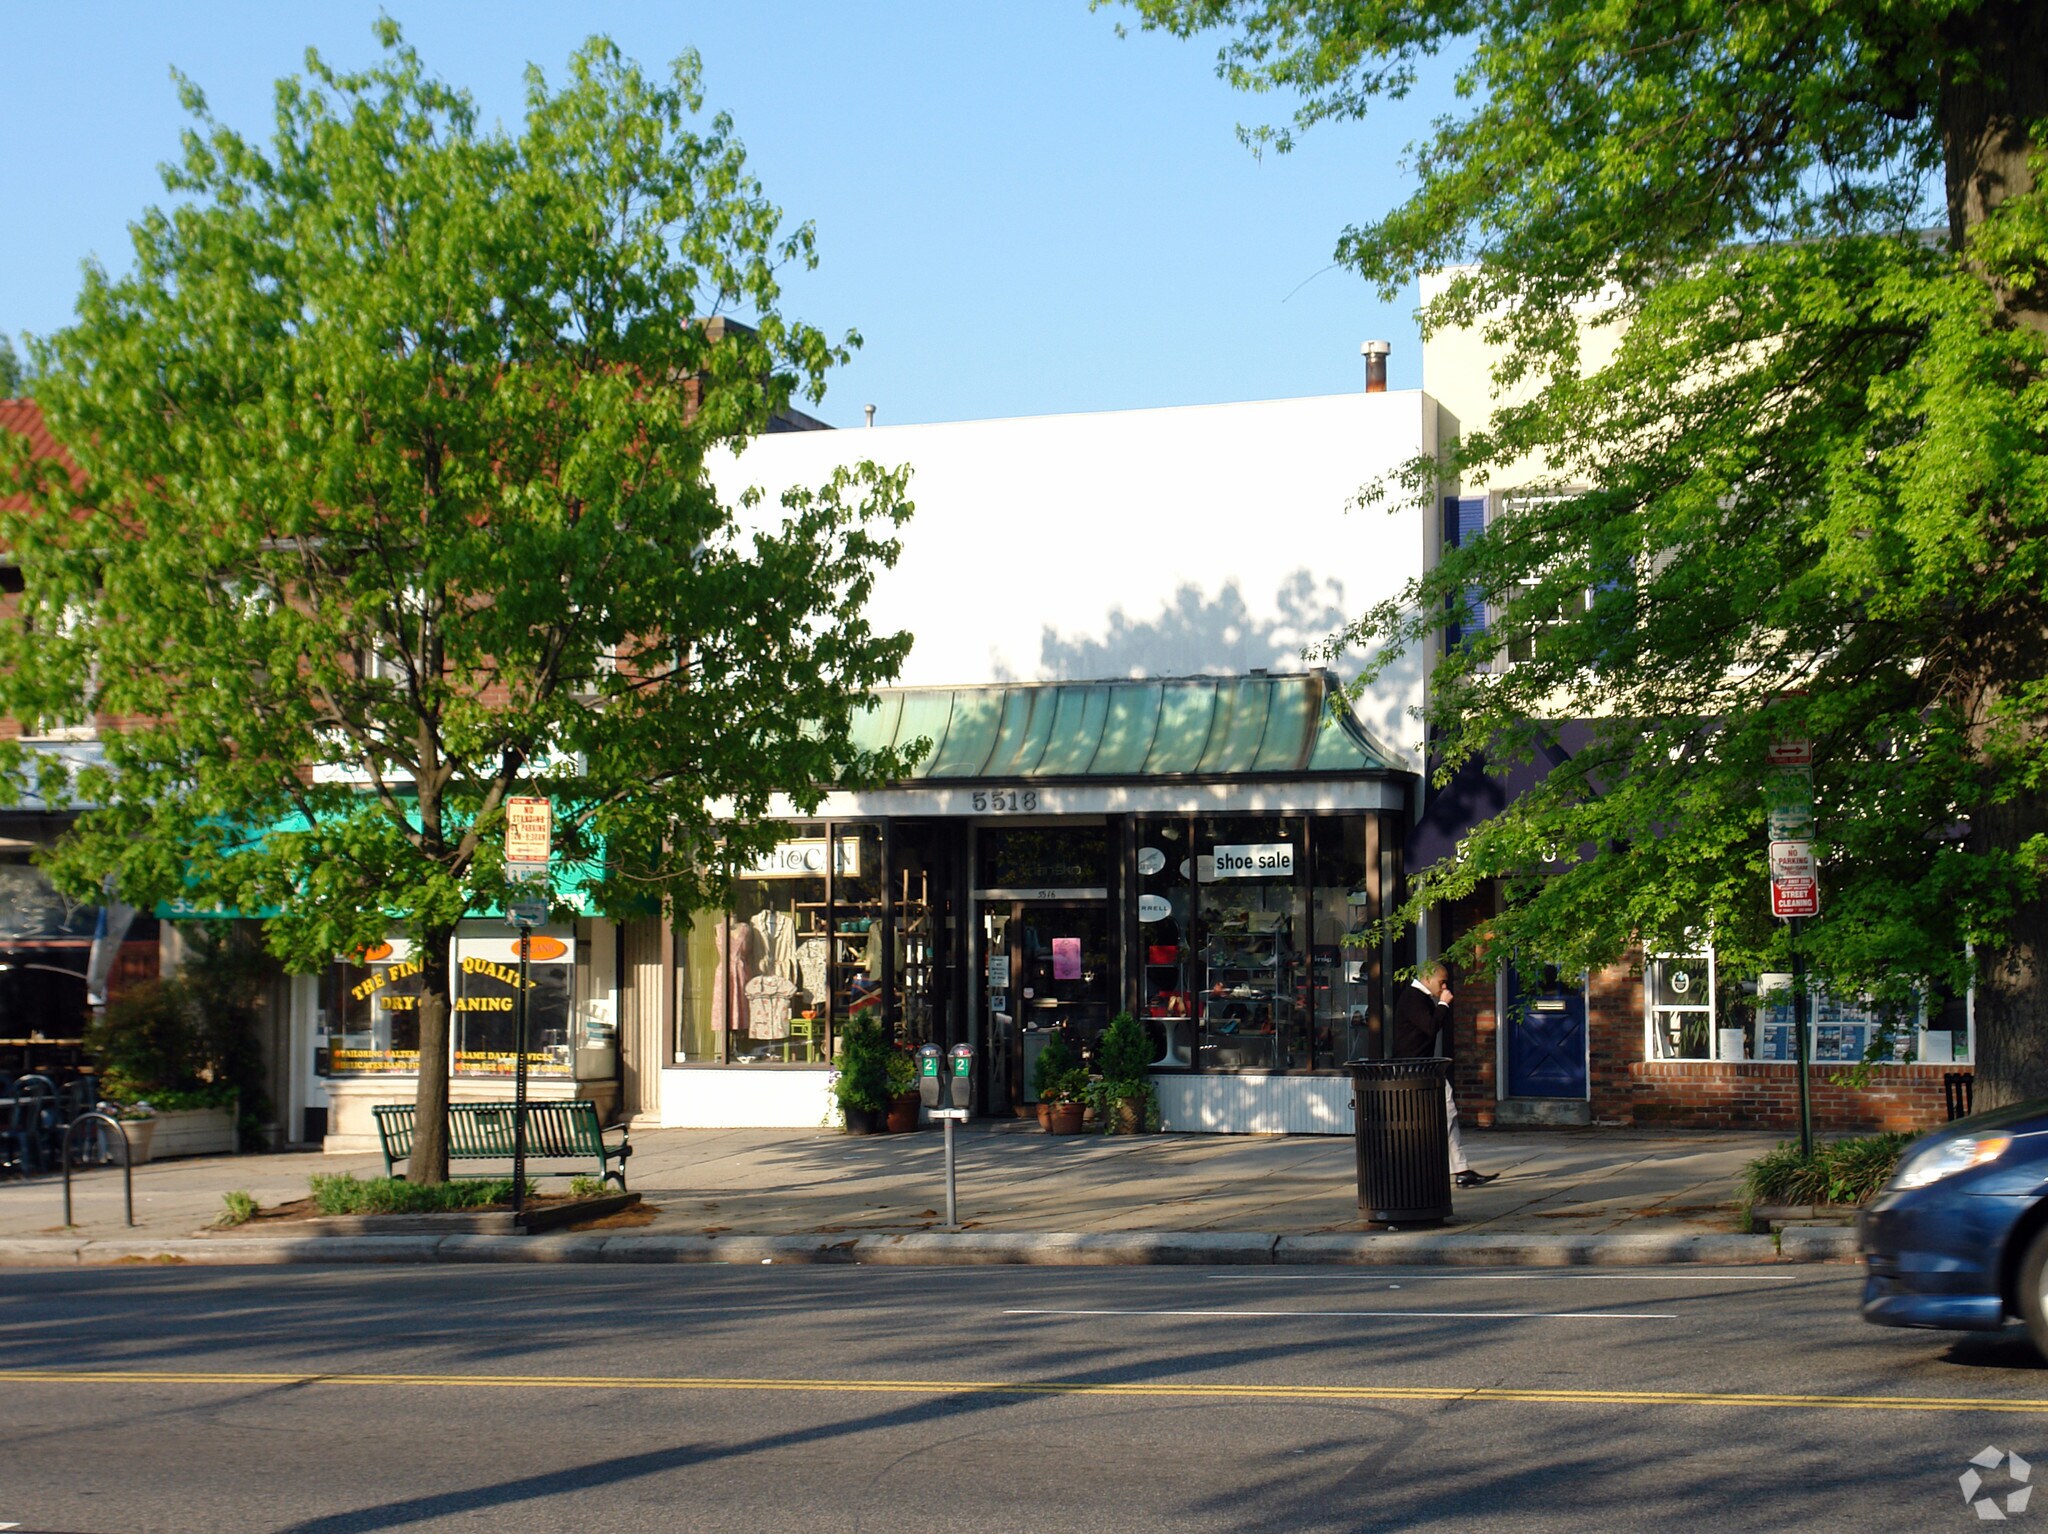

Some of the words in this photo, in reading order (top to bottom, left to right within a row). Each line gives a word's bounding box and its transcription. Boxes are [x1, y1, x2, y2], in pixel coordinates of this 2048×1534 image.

[972, 791, 1037, 811] 5518
[523, 806, 534, 814] NO
[512, 815, 545, 823] STANDING
[521, 824, 546, 832] PARKING
[1216, 853, 1253, 869] shoe
[1258, 851, 1290, 868] sale
[1778, 857, 1809, 865] PARKING
[1781, 890, 1809, 898] STREET
[1778, 899, 1813, 907] CLEANING
[351, 973, 386, 1001] THE
[388, 959, 425, 982] FIN
[380, 995, 416, 1011] DRY
[340, 1049, 383, 1058] TAILORING
[461, 1051, 484, 1060] SAME
[487, 1051, 508, 1061] DAY
[925, 1058, 933, 1070] 2
[957, 1058, 965, 1070] 2
